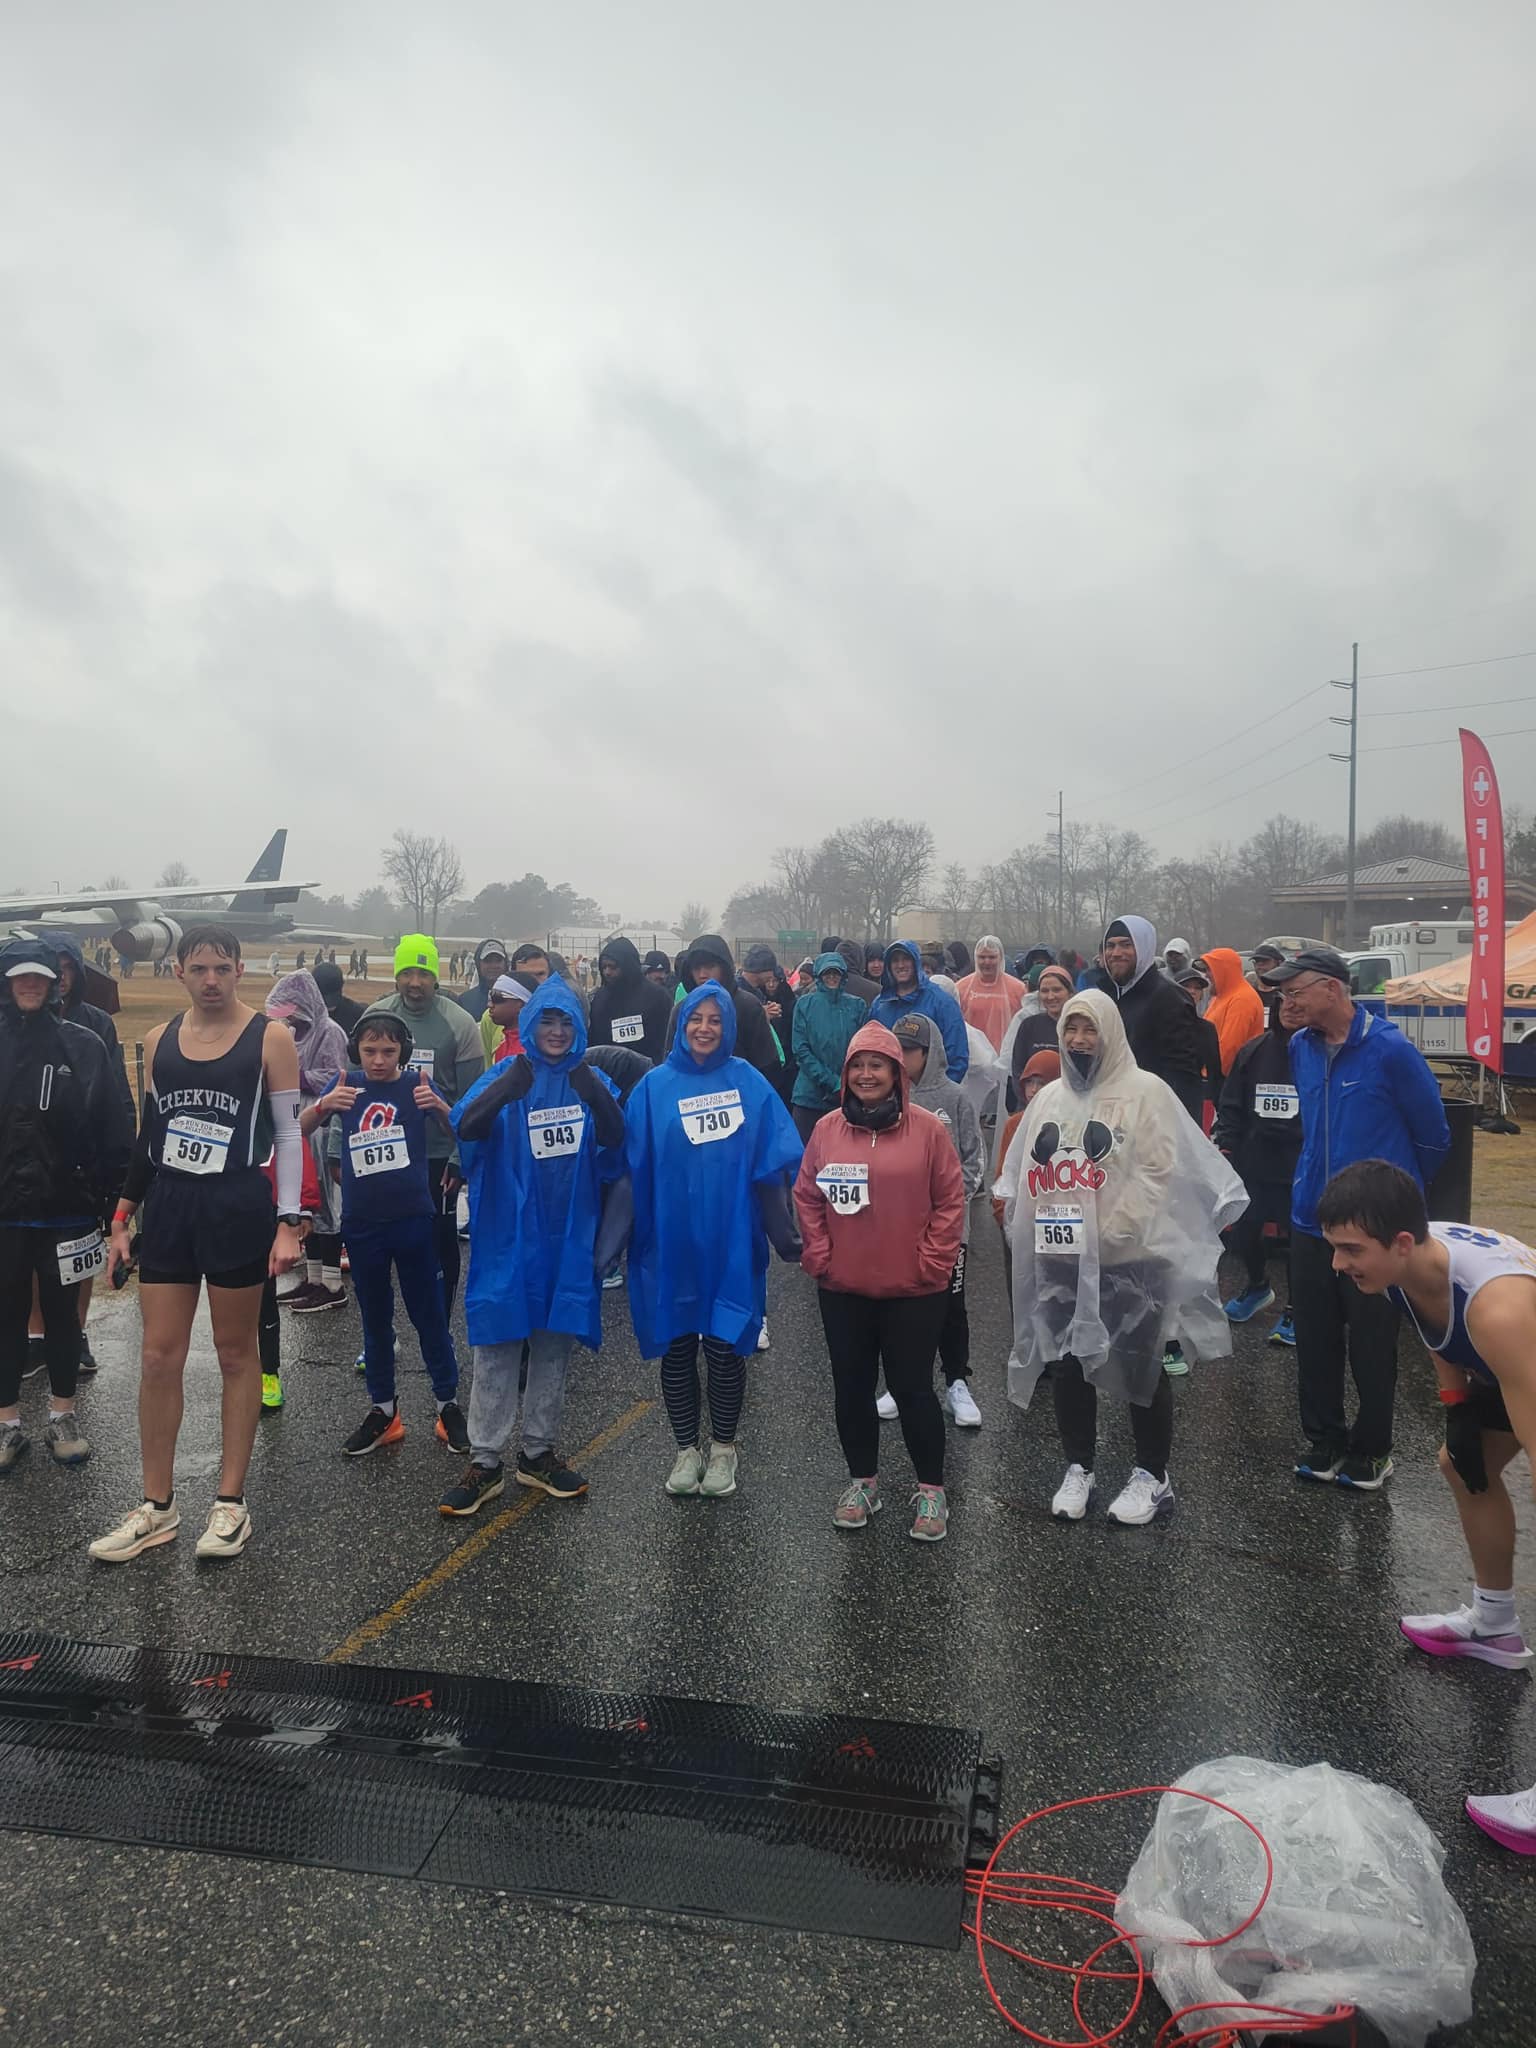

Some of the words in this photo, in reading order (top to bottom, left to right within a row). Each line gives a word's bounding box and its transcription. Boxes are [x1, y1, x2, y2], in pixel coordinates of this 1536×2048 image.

[619, 1026, 637, 1038] 619
[158, 1088, 240, 1116] CREEKVIEW
[1263, 1097, 1289, 1112] 695
[696, 1111, 731, 1134] 730
[543, 1126, 575, 1148] 943
[177, 1138, 213, 1165] 597
[363, 1144, 396, 1166] 673
[829, 1184, 861, 1205] 854
[1044, 1225, 1074, 1244] 563
[73, 1248, 102, 1273] 805
